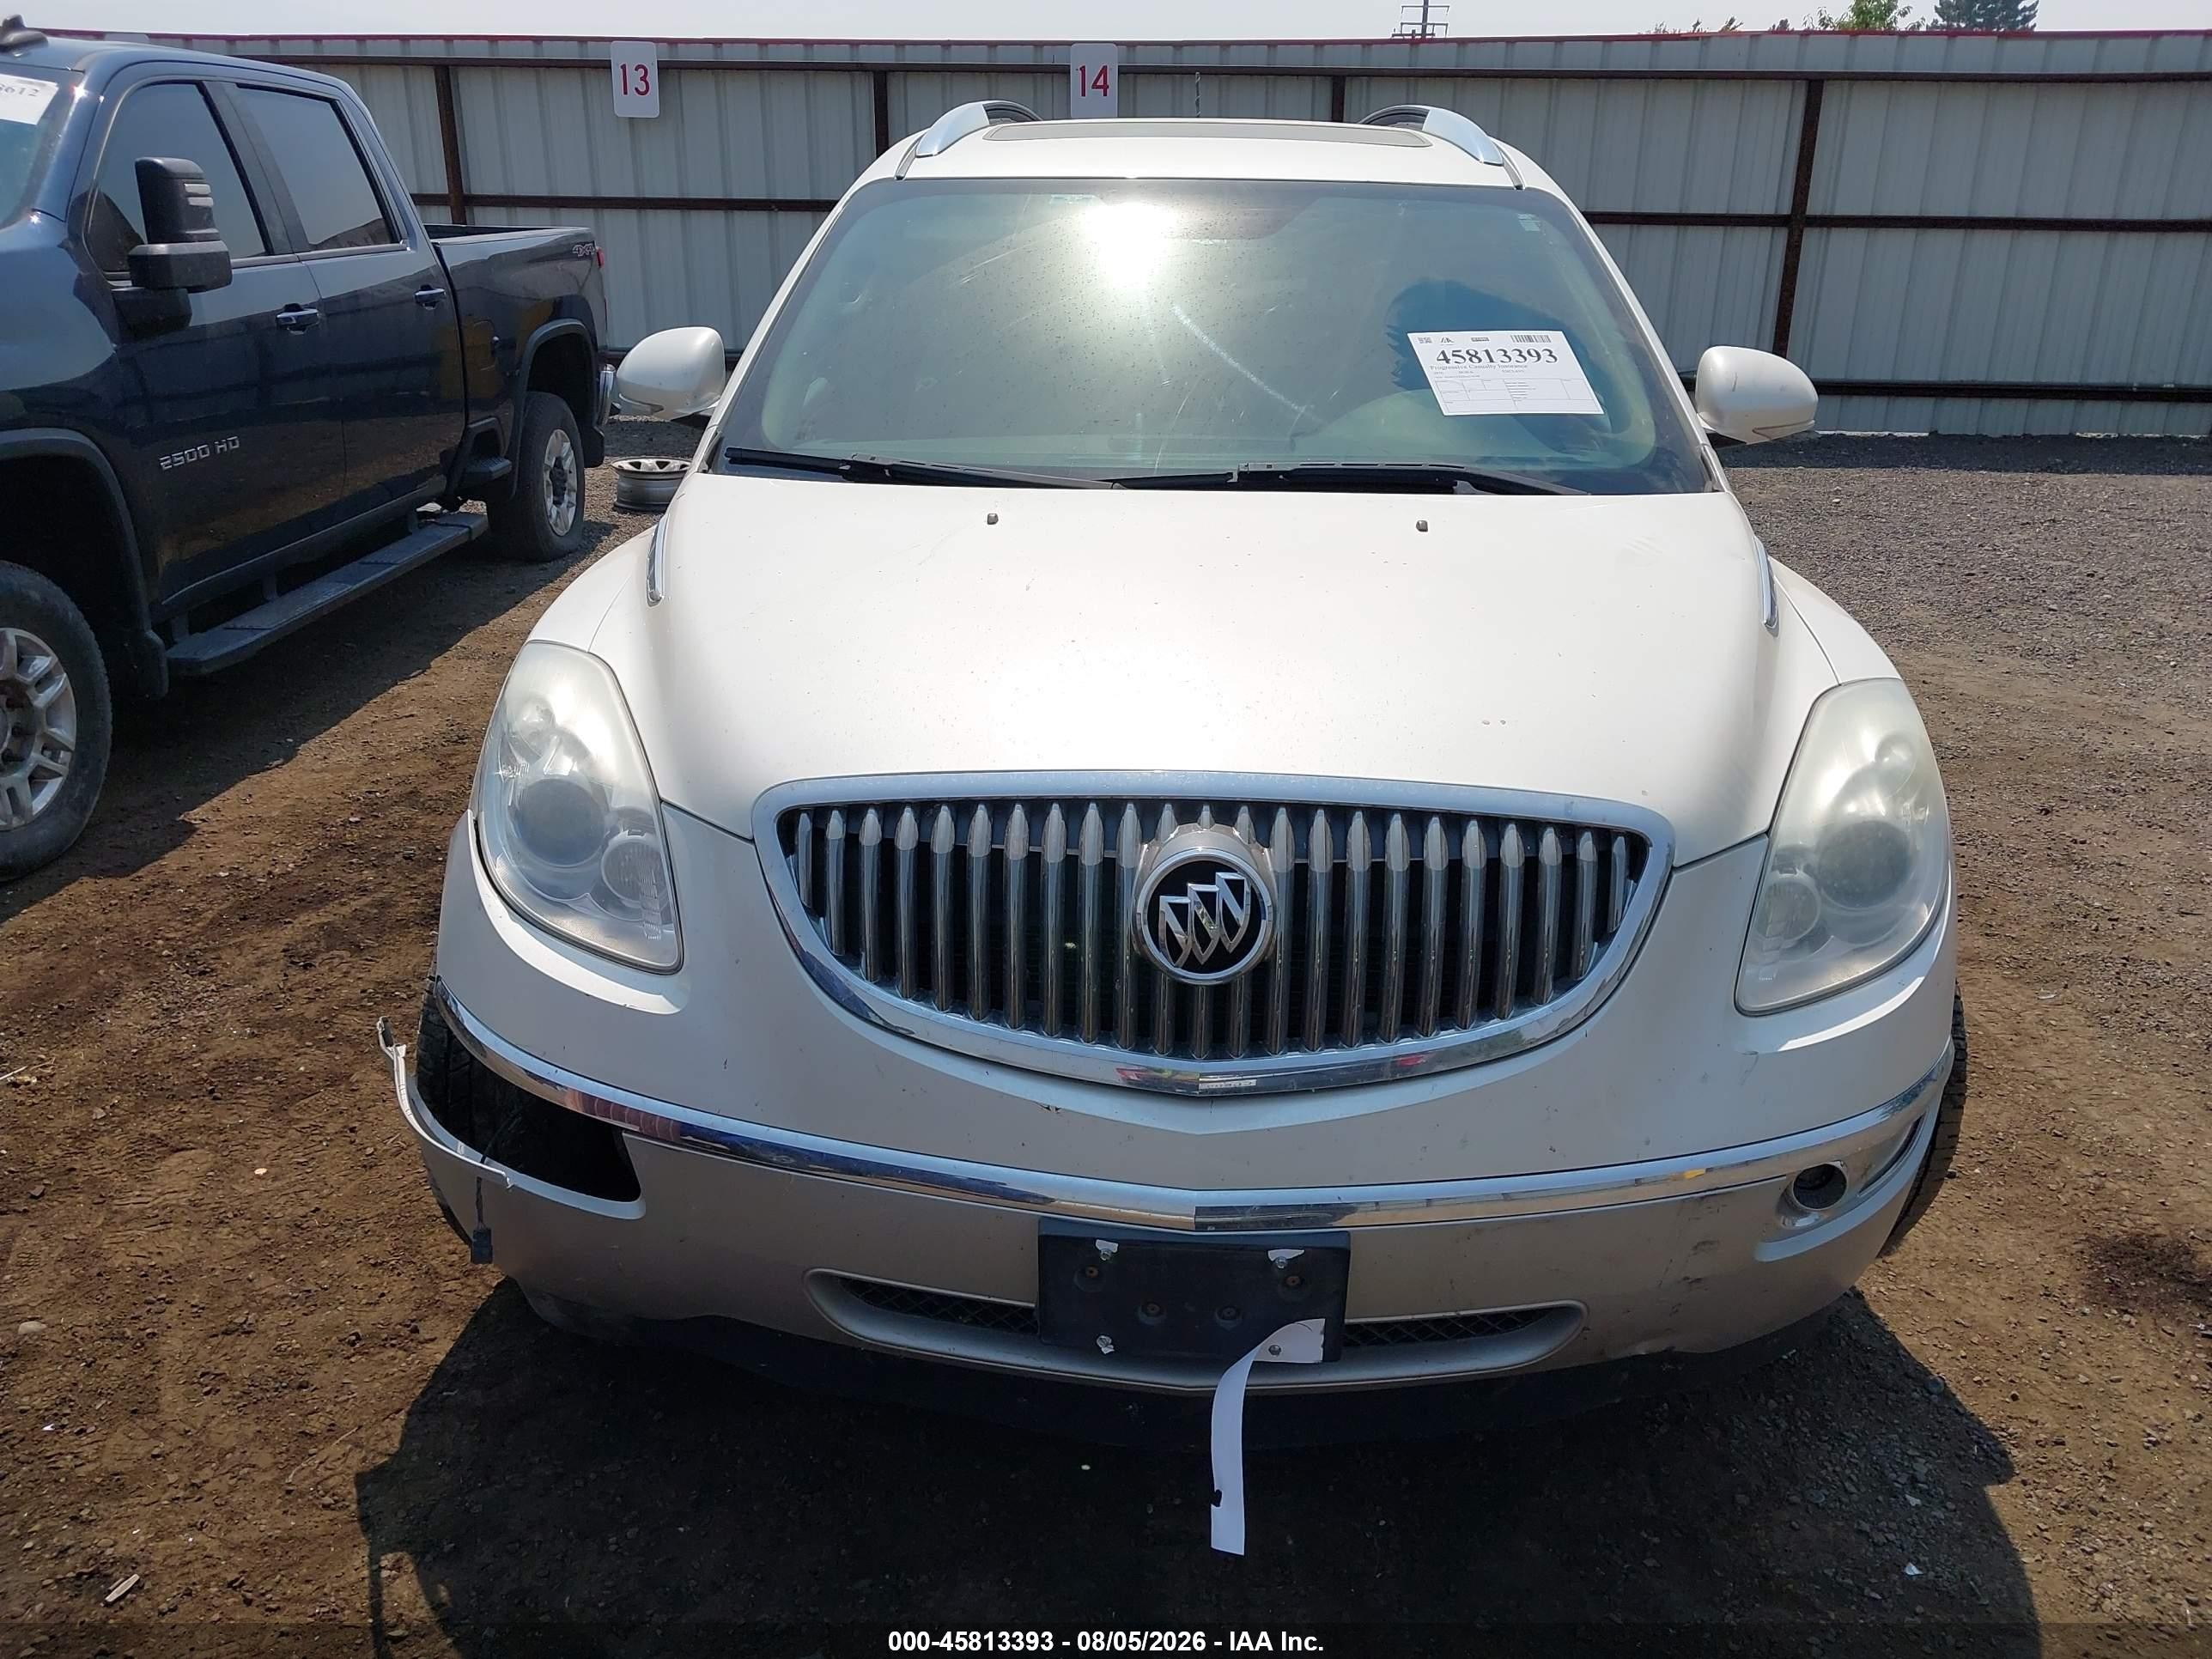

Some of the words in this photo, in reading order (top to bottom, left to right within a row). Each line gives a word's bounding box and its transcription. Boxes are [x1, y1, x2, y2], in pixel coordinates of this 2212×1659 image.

[620, 63, 650, 96] 13
[1079, 64, 1109, 97] 14
[1436, 348, 1559, 364] 45813393
[159, 444, 210, 471] 2500
[214, 436, 240, 454] HD
